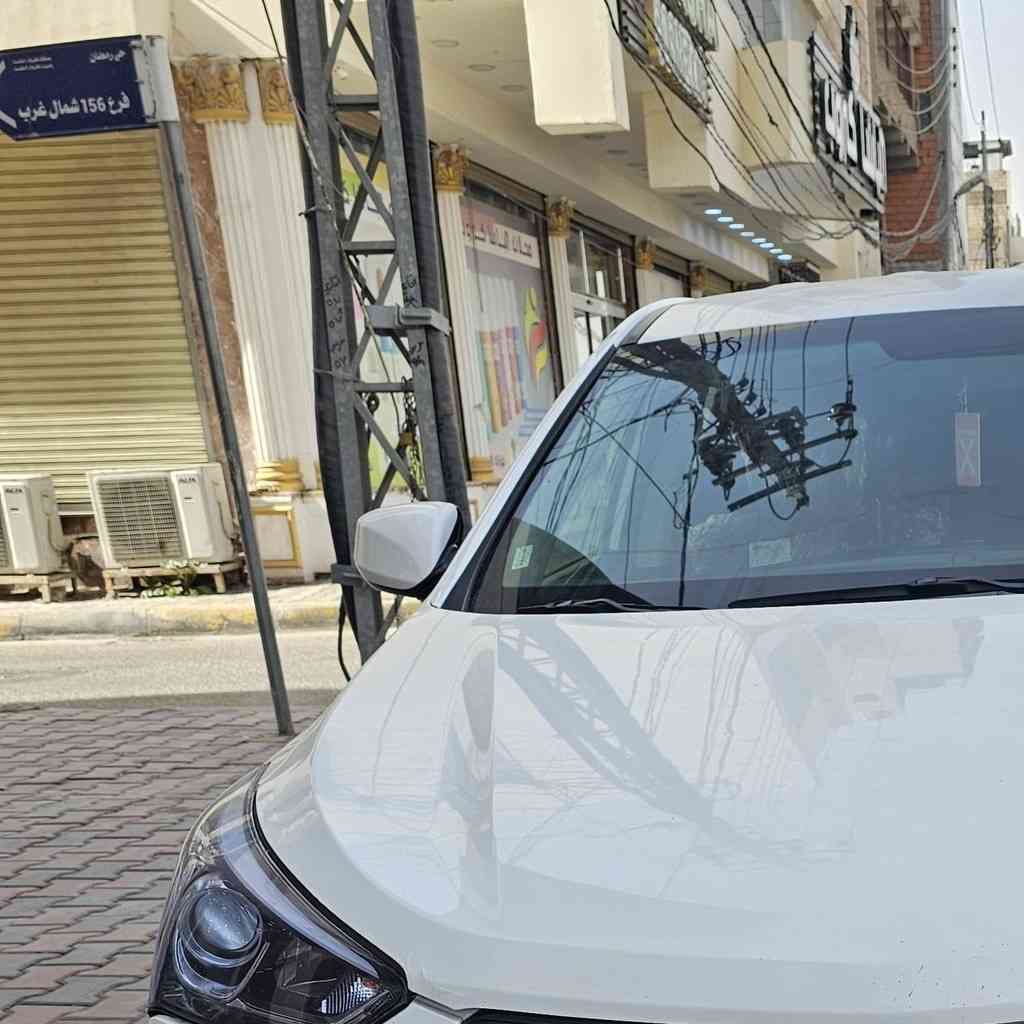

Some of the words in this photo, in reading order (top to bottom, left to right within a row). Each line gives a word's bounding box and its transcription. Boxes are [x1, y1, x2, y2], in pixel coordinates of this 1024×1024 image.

[18, 100, 47, 122] غرب
[50, 98, 80, 119] شمال
[81, 97, 106, 113] 156
[107, 92, 130, 115] فرع
